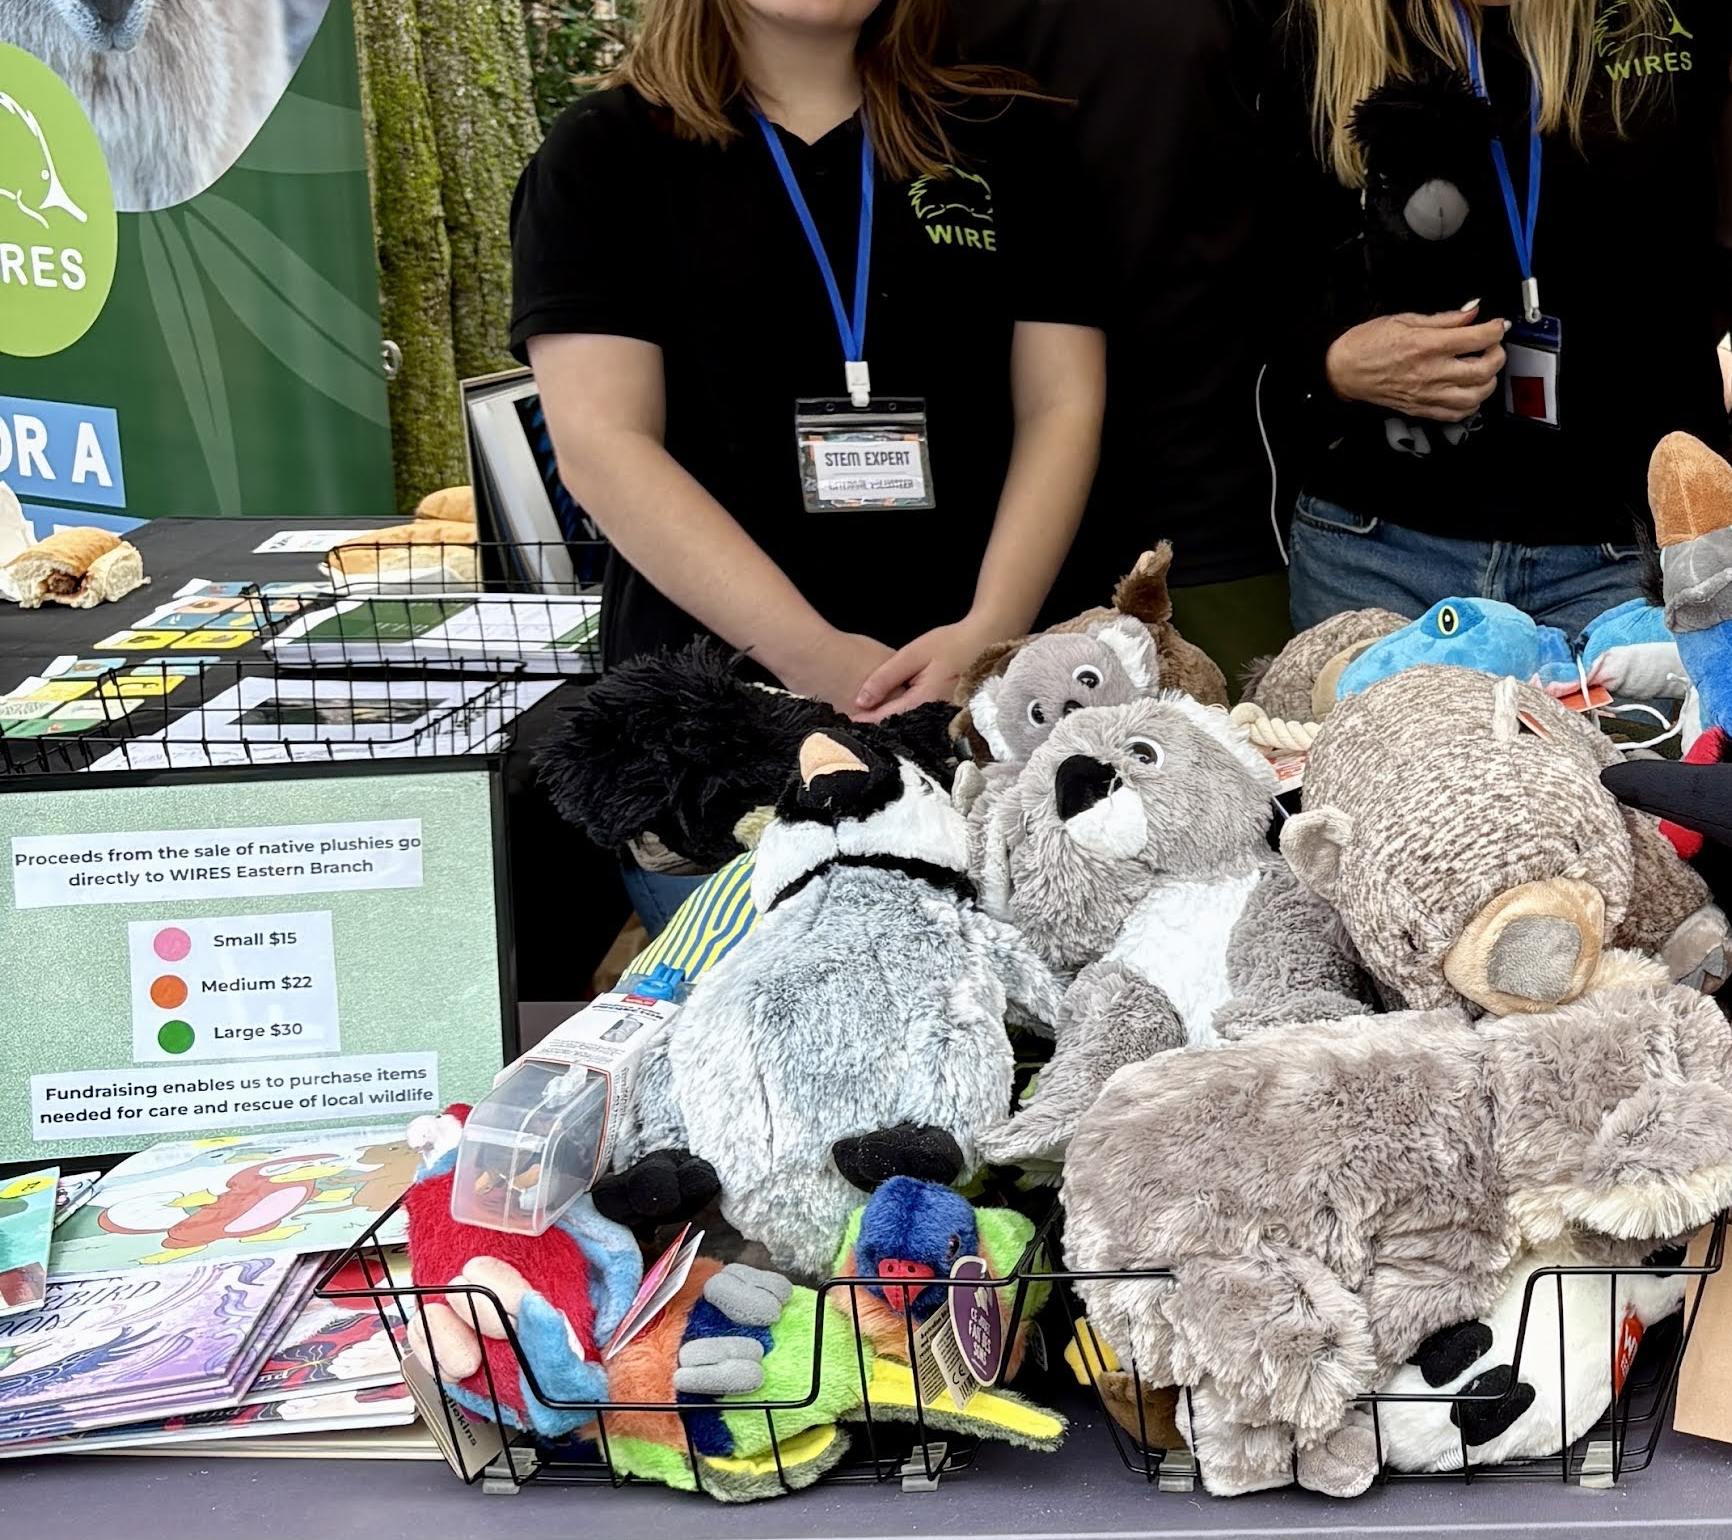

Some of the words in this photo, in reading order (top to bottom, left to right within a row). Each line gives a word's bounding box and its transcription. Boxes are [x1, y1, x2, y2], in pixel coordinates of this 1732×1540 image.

[1604, 51, 1693, 81] WIRES
[924, 224, 997, 252] WIRE
[71, 422, 113, 487] A
[824, 451, 861, 467] STEM
[864, 451, 910, 466] EXPERT
[15, 850, 103, 866] Proceeds
[107, 848, 153, 862] from
[157, 846, 189, 860] the
[194, 844, 231, 858] sale
[236, 842, 254, 856] of
[259, 842, 315, 855] native
[320, 837, 394, 855] plushies
[398, 838, 421, 851] go
[68, 870, 140, 887] directly
[145, 871, 164, 883] to
[169, 866, 231, 881] WIRES
[236, 865, 305, 878] Eastern
[310, 859, 373, 875] Branch
[213, 932, 264, 947] Small
[269, 931, 297, 946] $15
[201, 977, 276, 993] Medium
[281, 975, 313, 990] $22
[214, 1027, 265, 1041] Large
[270, 1022, 303, 1037] $30
[46, 1082, 158, 1101] Fundraising
[163, 1078, 235, 1094] enables
[240, 1079, 261, 1089] us
[265, 1076, 284, 1088] to
[290, 1071, 373, 1090] purchase
[378, 1069, 427, 1081] items
[40, 1106, 112, 1124] needed
[116, 1106, 144, 1120] for
[148, 1106, 188, 1118] care
[193, 1100, 228, 1115] and
[234, 1099, 294, 1113] rescue
[299, 1094, 318, 1108] of
[322, 1092, 364, 1107] local
[369, 1088, 434, 1104] wildlife
